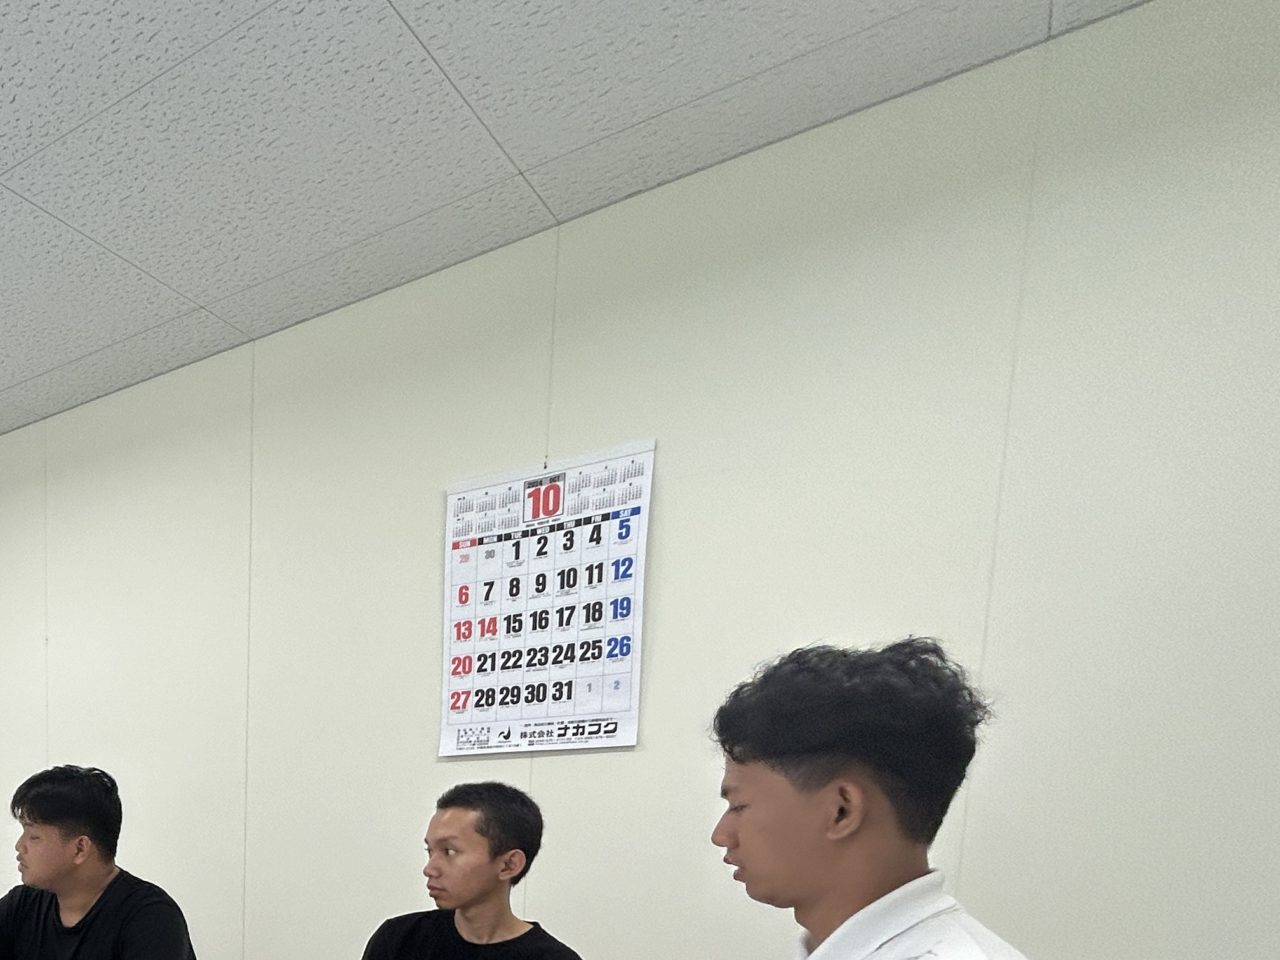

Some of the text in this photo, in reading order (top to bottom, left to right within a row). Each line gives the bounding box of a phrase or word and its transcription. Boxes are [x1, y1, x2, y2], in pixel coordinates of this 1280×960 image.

[527, 484, 560, 519] 10
[620, 508, 631, 517] SAT
[485, 549, 496, 560] 30
[512, 541, 520, 560] 1
[536, 536, 548, 556] 2
[562, 530, 574, 550] 3
[589, 524, 602, 545] 4
[618, 518, 630, 540] 5
[458, 557, 634, 604] 6 7 8 9 10 11 12
[454, 597, 631, 640] 13 14 15 16 17 18 19
[452, 636, 632, 676] 20 21 22 23 24 25 26
[450, 680, 620, 710] 27 28 29 30 31 1 2
[520, 730, 554, 740] 株式会社
